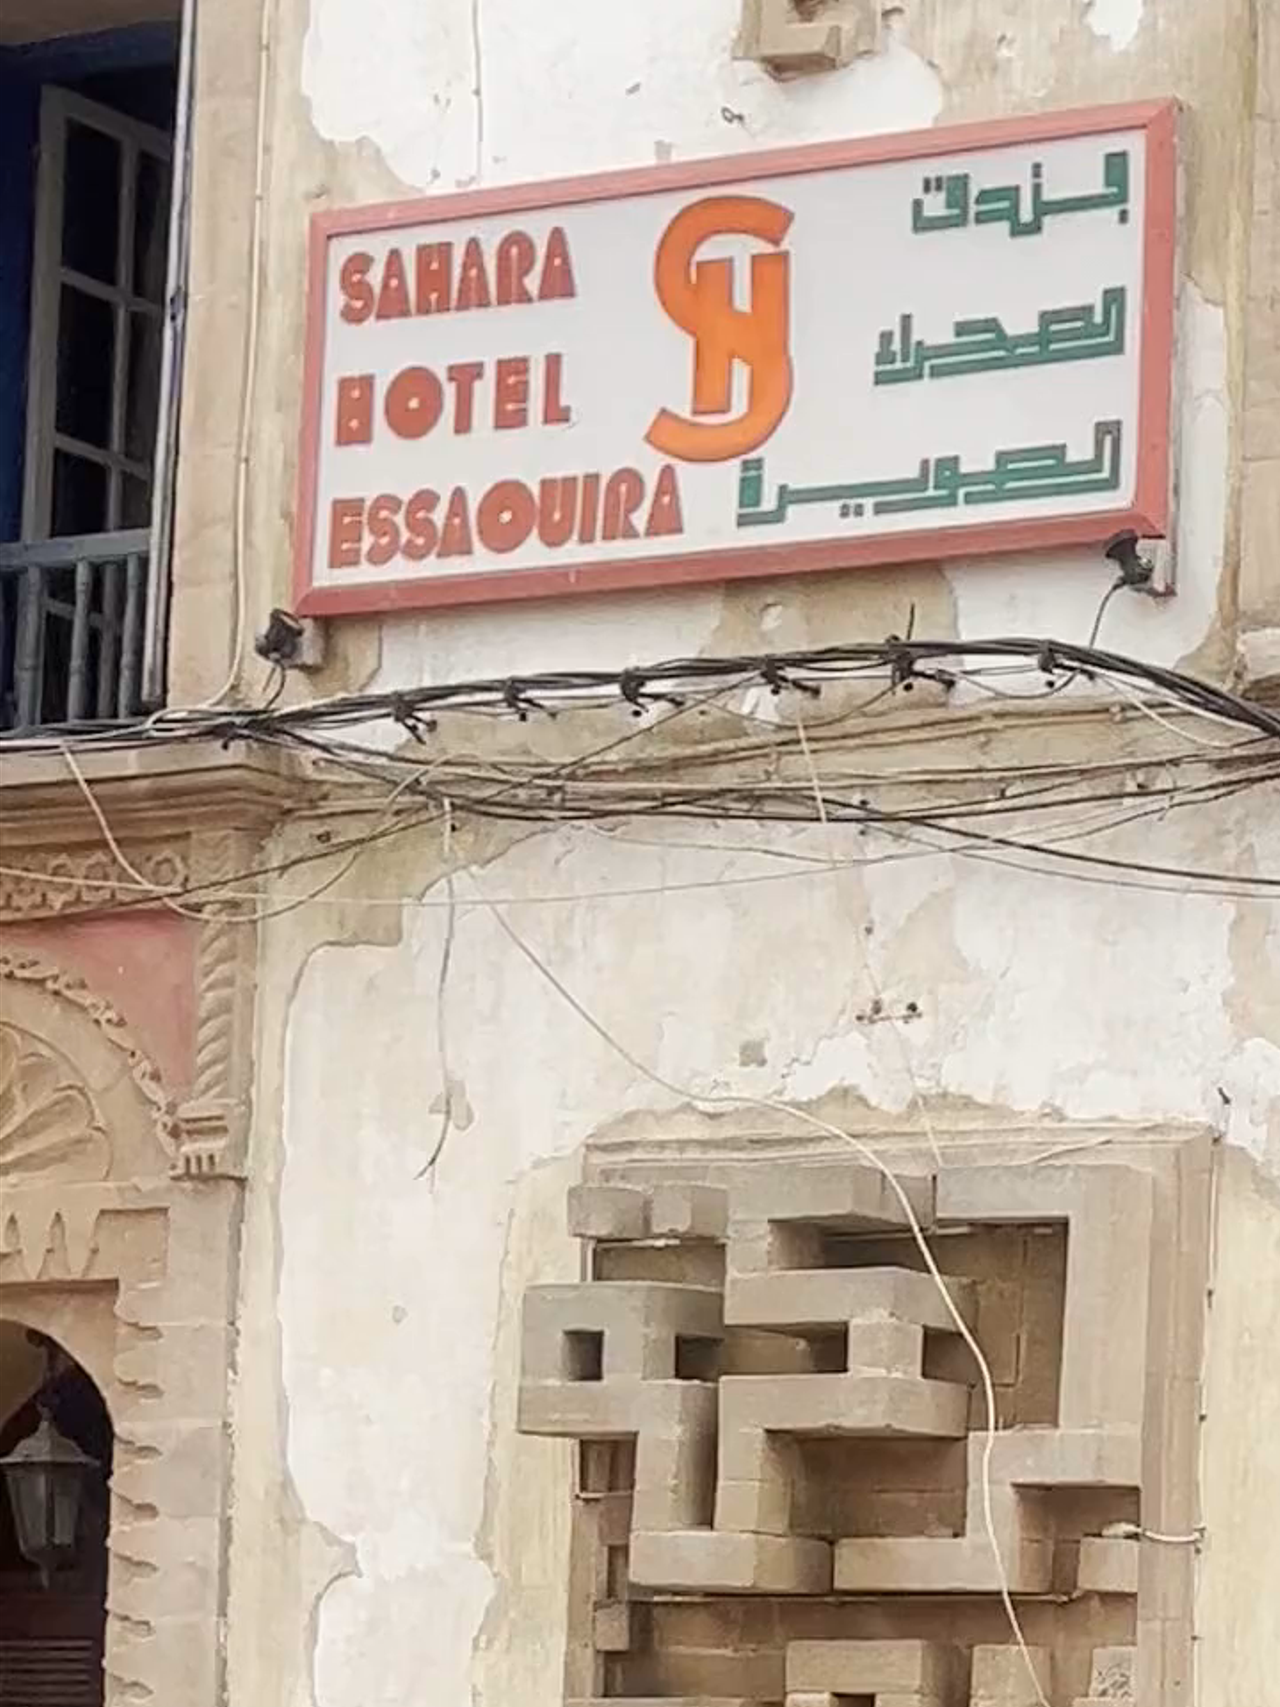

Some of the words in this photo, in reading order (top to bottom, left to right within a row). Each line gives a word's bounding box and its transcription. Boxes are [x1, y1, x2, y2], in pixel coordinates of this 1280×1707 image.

[340, 225, 577, 326] SAHARA
[335, 352, 572, 447] HOTEL
[327, 463, 684, 569] ESSAOUIRA
